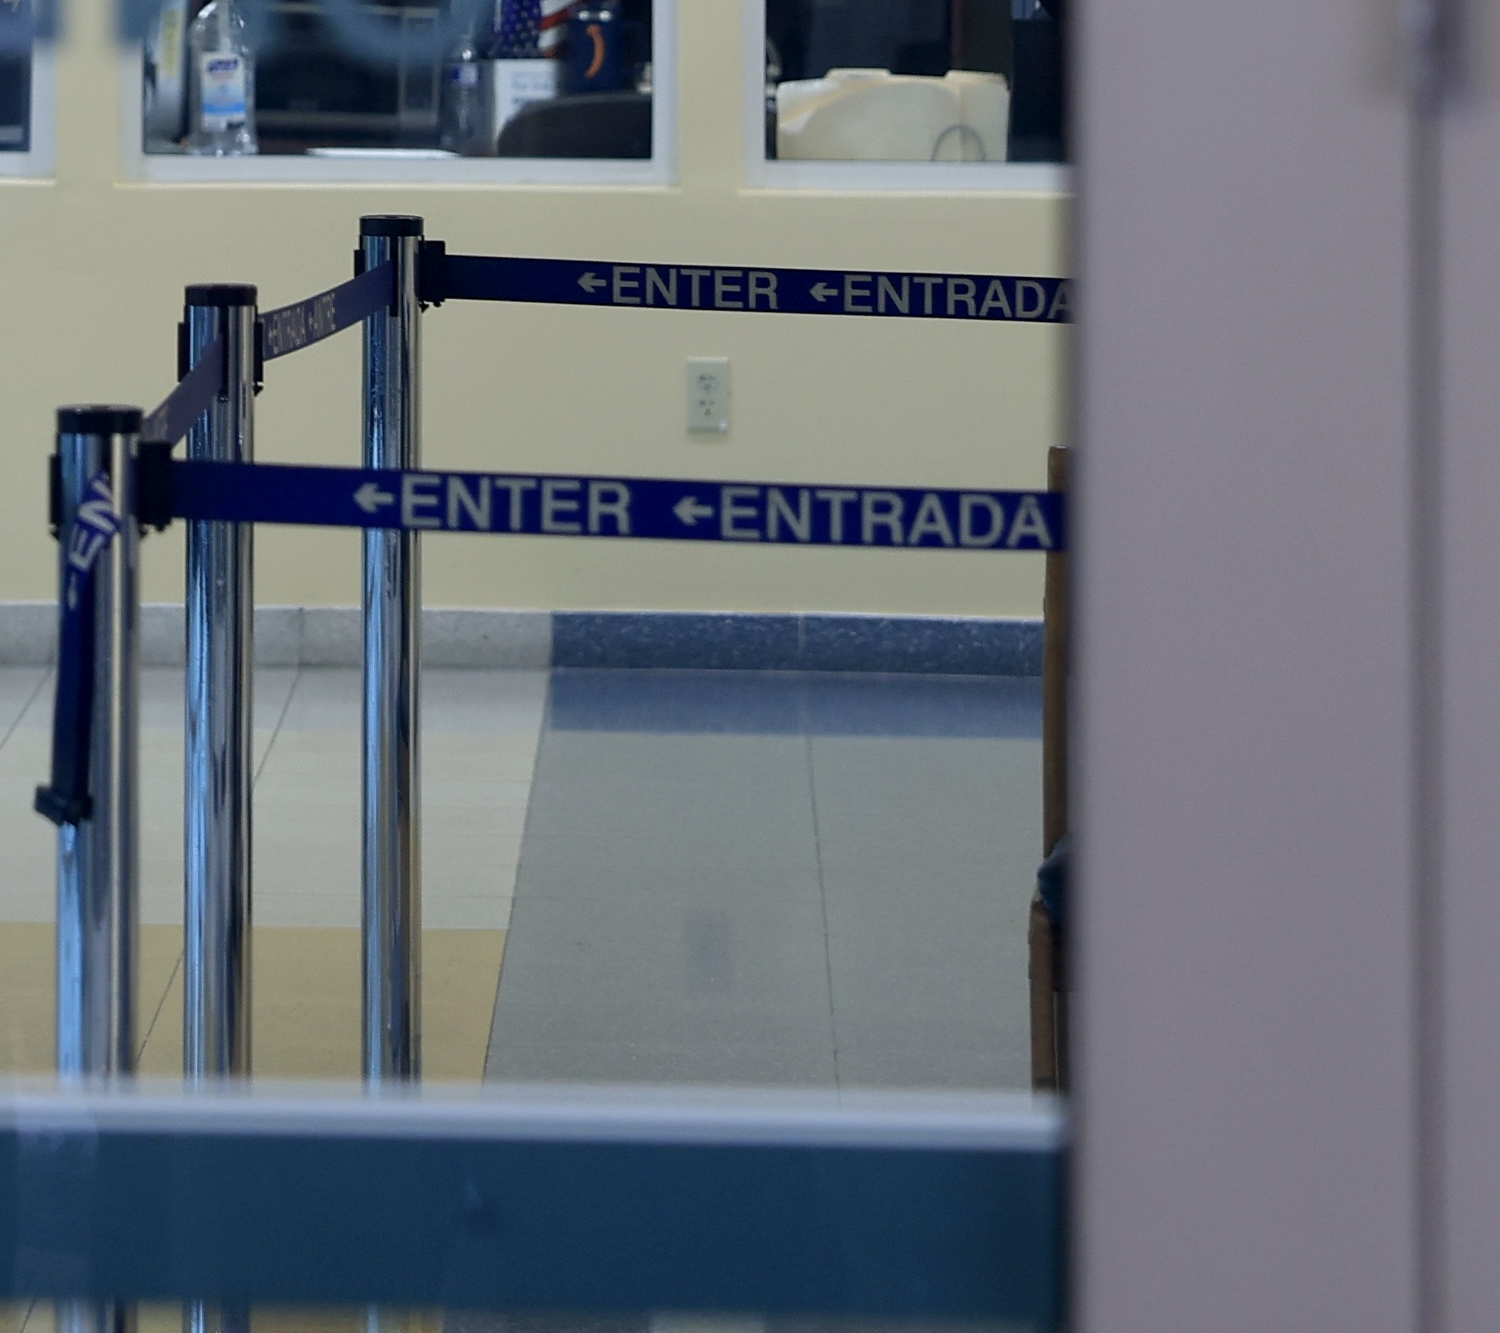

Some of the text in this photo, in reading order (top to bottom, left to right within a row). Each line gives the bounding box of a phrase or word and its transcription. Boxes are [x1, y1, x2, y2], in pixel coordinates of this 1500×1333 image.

[611, 264, 779, 310] ENTER
[401, 472, 1054, 549] ENTER ENTRADA
